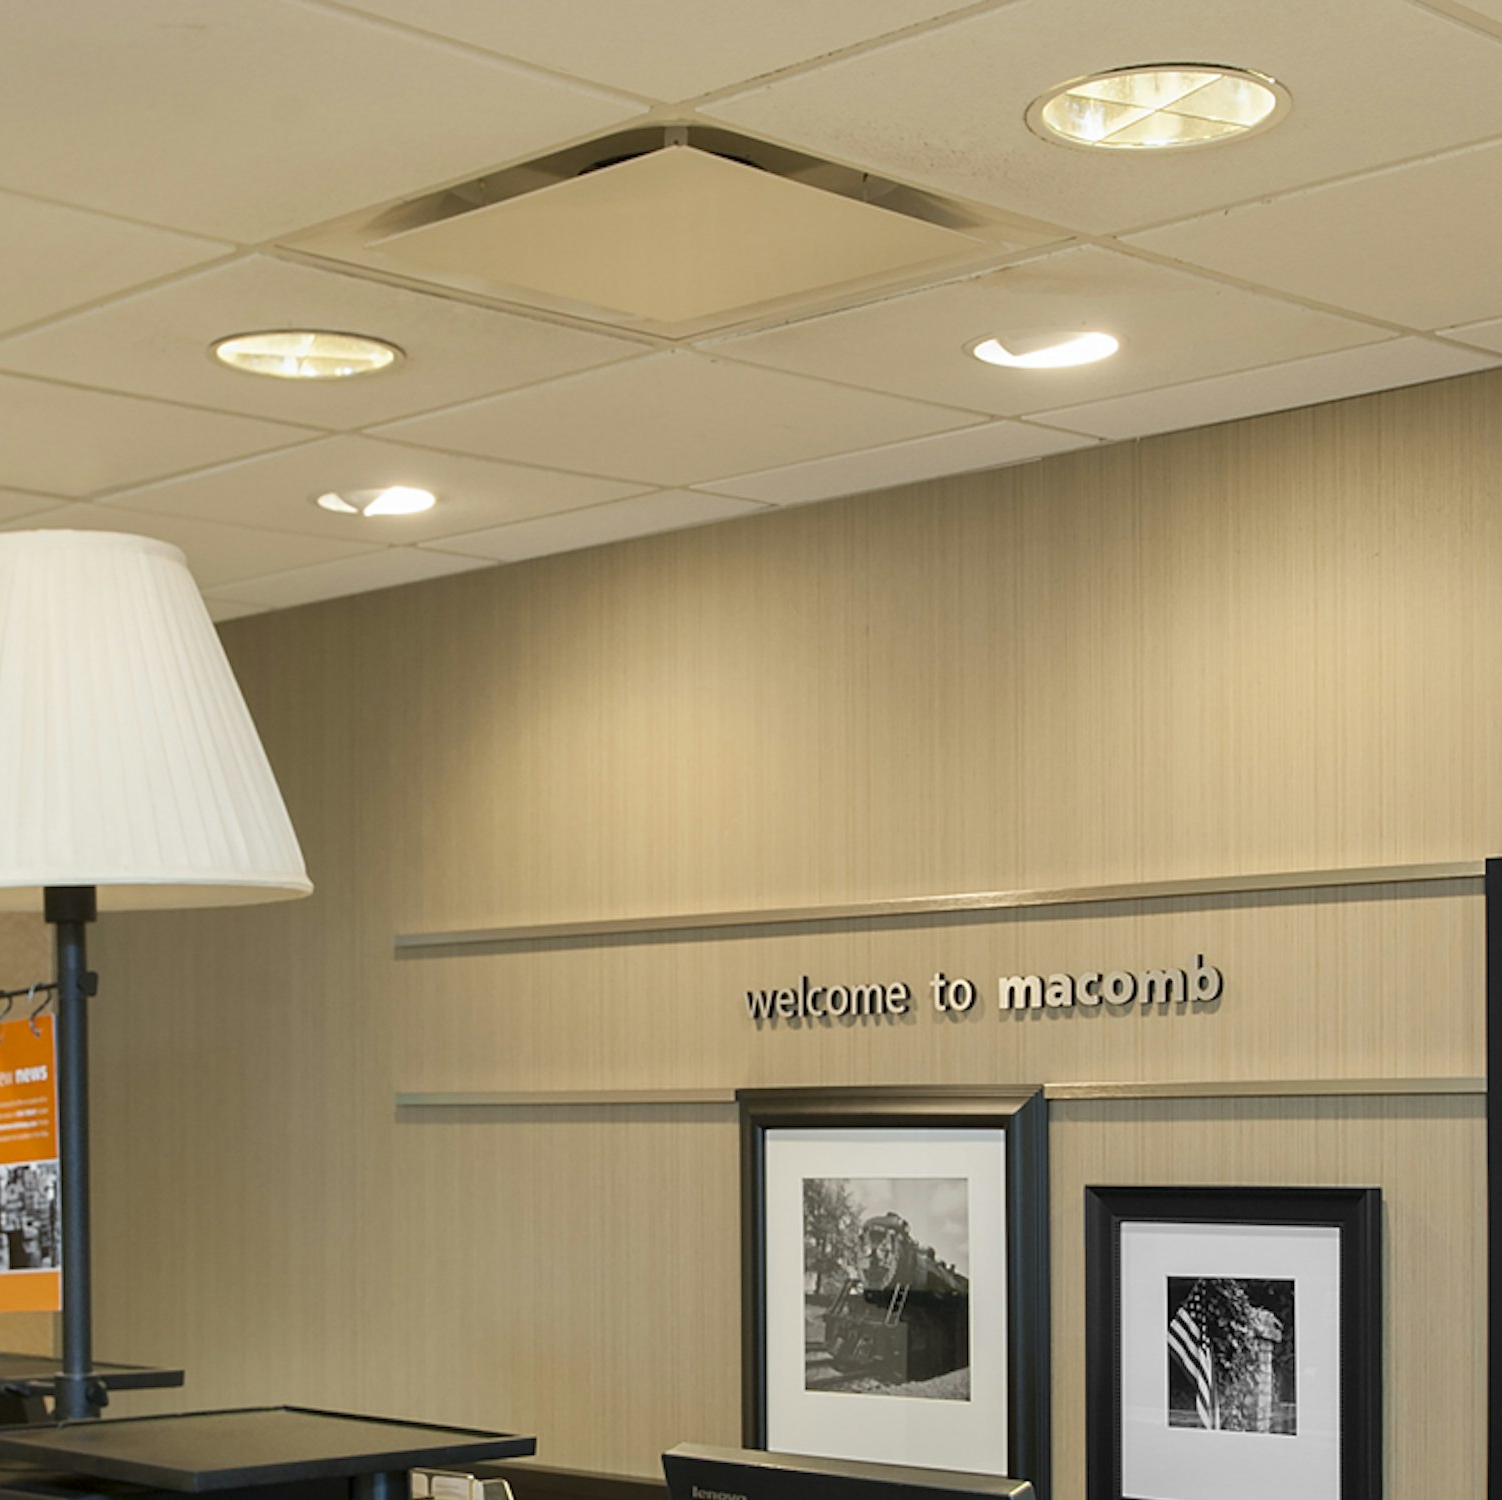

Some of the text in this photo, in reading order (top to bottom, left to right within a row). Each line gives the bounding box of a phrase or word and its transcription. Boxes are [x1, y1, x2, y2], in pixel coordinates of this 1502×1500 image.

[744, 954, 1223, 1019] welcome to macomb
